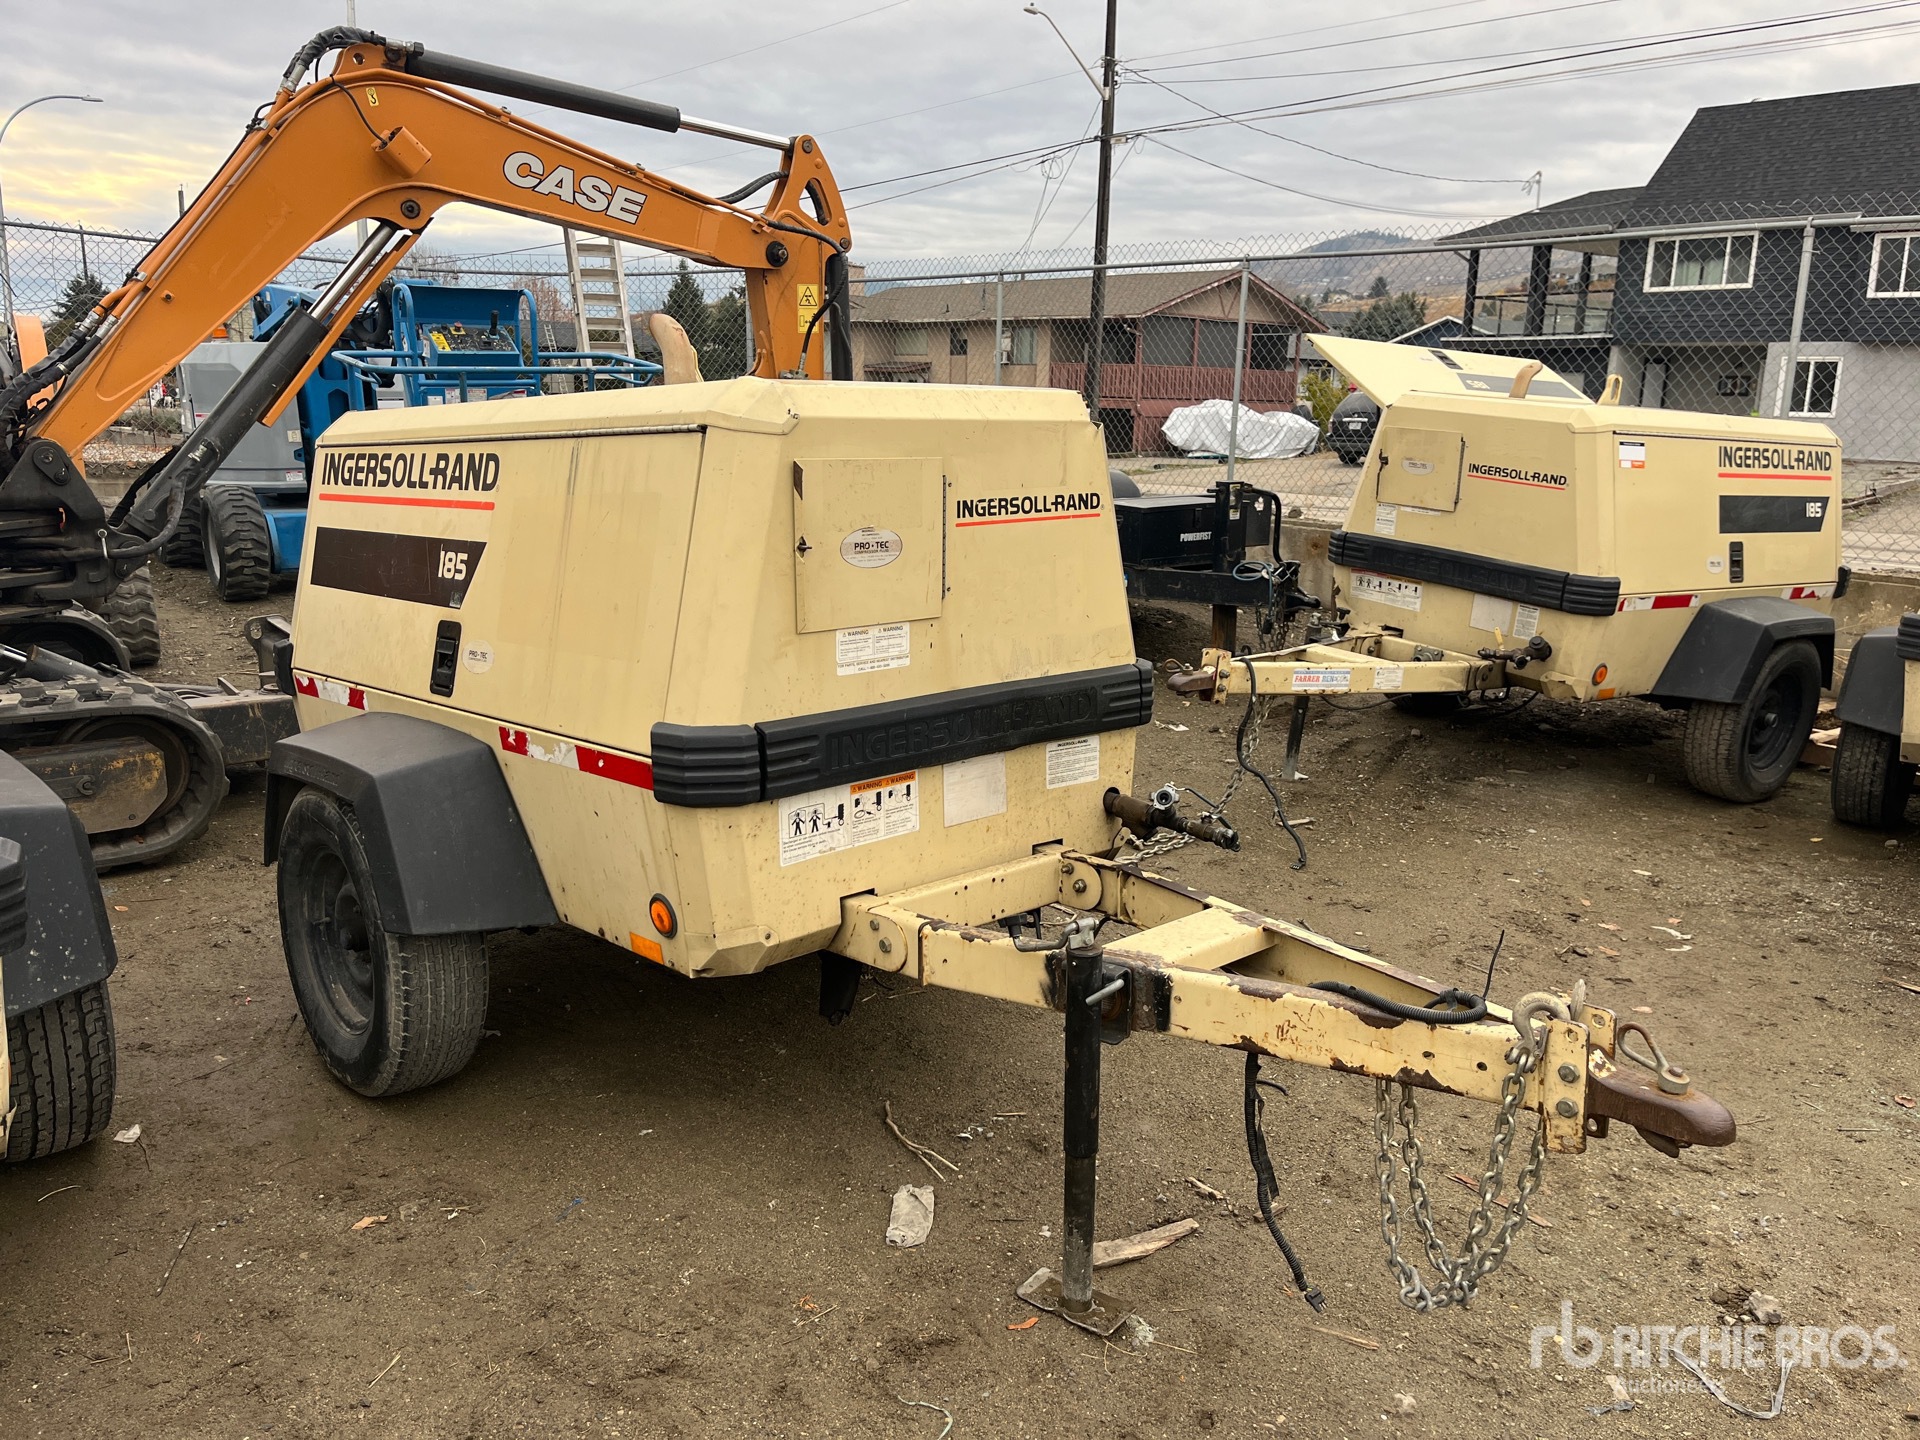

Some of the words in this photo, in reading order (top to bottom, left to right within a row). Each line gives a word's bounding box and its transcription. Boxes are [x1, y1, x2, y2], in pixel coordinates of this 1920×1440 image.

[503, 151, 648, 225] CASE
[1718, 446, 1832, 471] INGERSOLL-RAND
[321, 452, 500, 492] INGERSOLL-RAND
[1468, 462, 1567, 486] INGERSOLL-RAND
[956, 492, 1101, 519] INGERSOLL-RAND
[1805, 502, 1822, 518] 185
[1179, 531, 1212, 542] POWERFIST
[437, 549, 468, 581] 185
[847, 629, 869, 637] WARNING
[1294, 675, 1321, 683] FARRER
[857, 781, 883, 792] WARNING
[889, 773, 914, 784] WARNING
